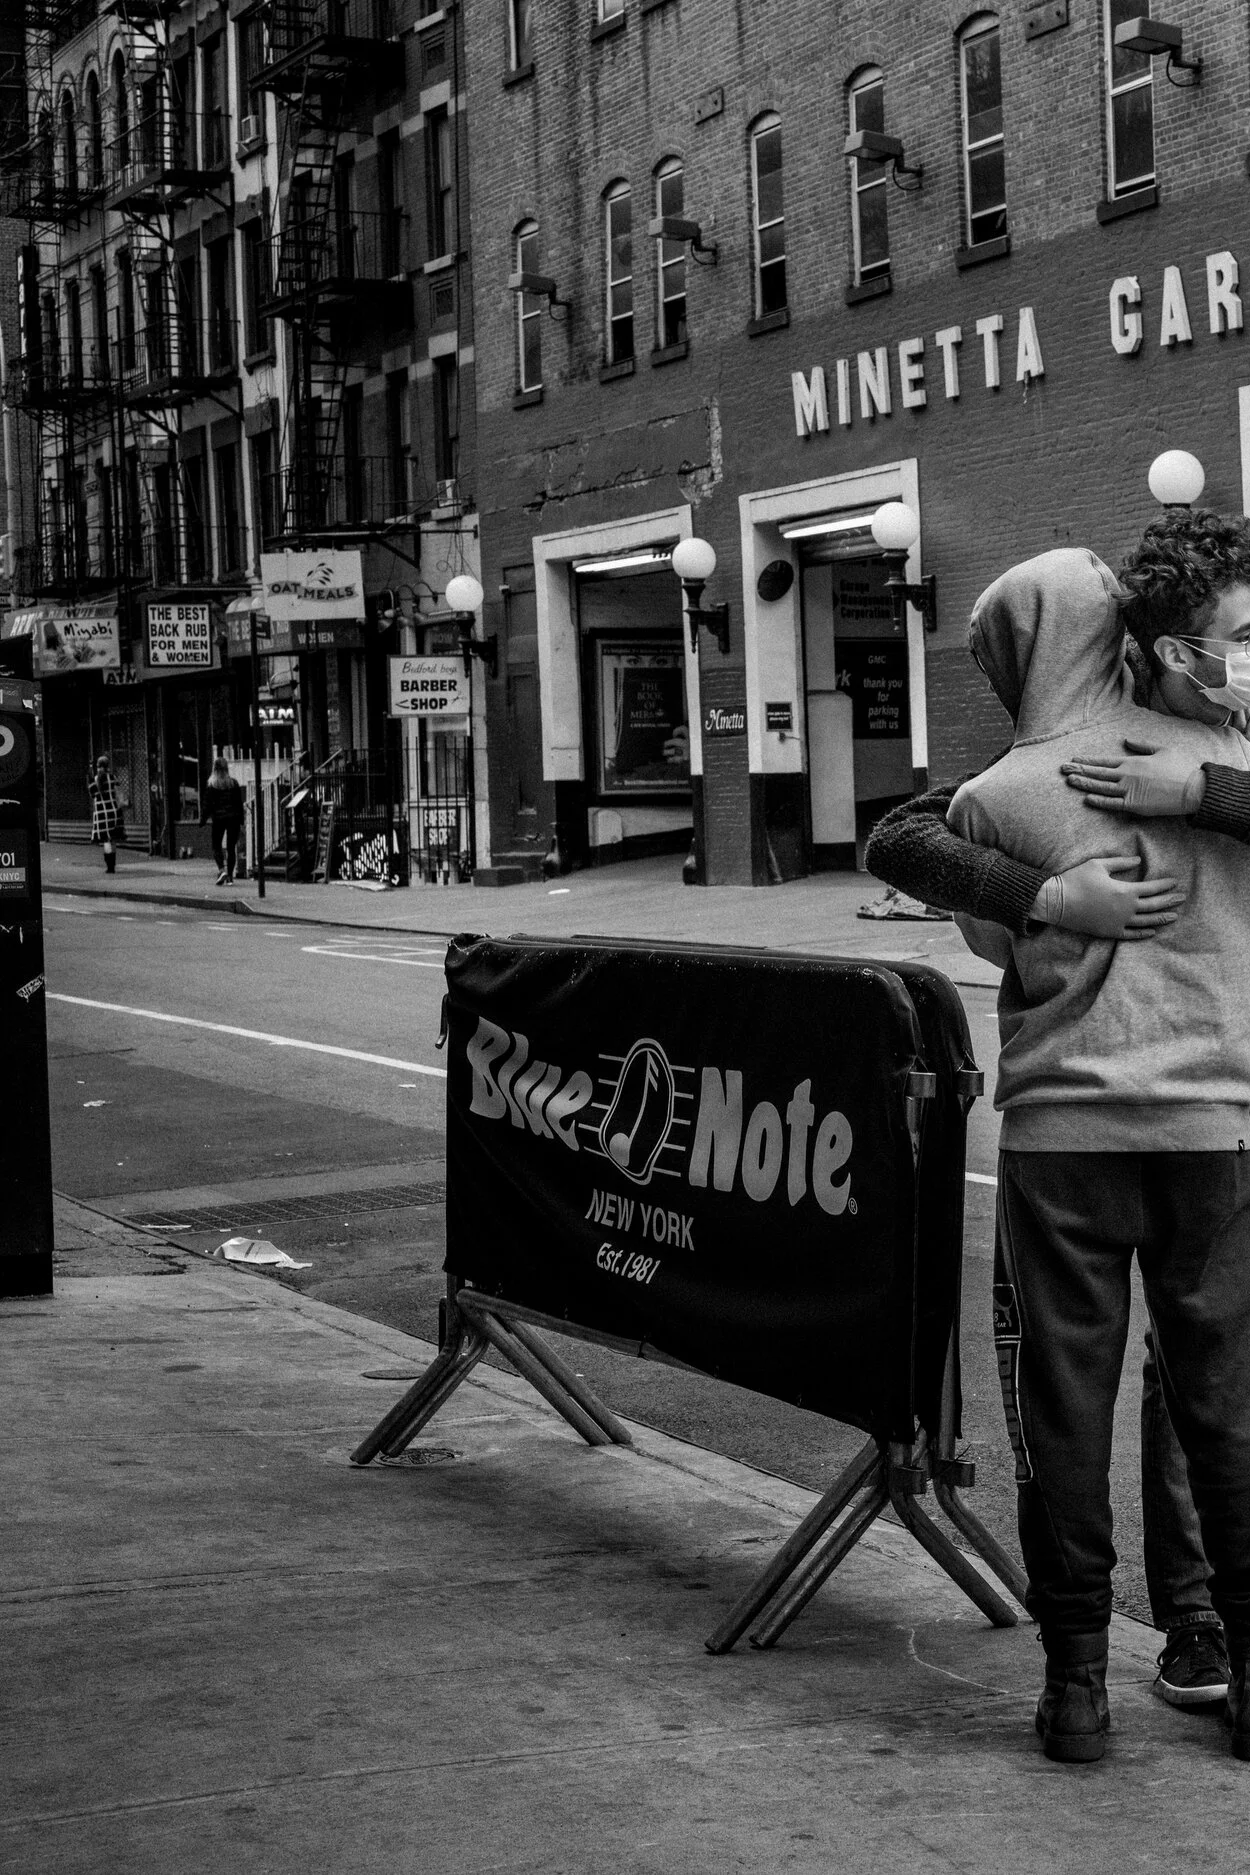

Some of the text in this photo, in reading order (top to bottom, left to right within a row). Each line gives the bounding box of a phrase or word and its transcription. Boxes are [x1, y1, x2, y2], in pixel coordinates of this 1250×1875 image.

[792, 306, 1044, 436] MINETTA
[271, 583, 354, 599] OAT MEALS
[150, 606, 206, 621] THE BEST
[64, 621, 113, 640] Miyabi
[150, 622, 208, 637] BACK RUB
[152, 639, 208, 650] FOR MEN
[152, 652, 209, 662] & WOMEN
[401, 680, 458, 692] BARBER
[863, 678, 903, 690] thank you
[877, 691, 890, 702] for
[411, 698, 448, 710] SHOP
[258, 706, 295, 719] ATM
[868, 706, 900, 719] parking
[704, 709, 745, 731] Minetta
[869, 719, 899, 730] with us
[466, 1015, 854, 1216] Blue Note
[584, 1188, 696, 1251] NEW YORK
